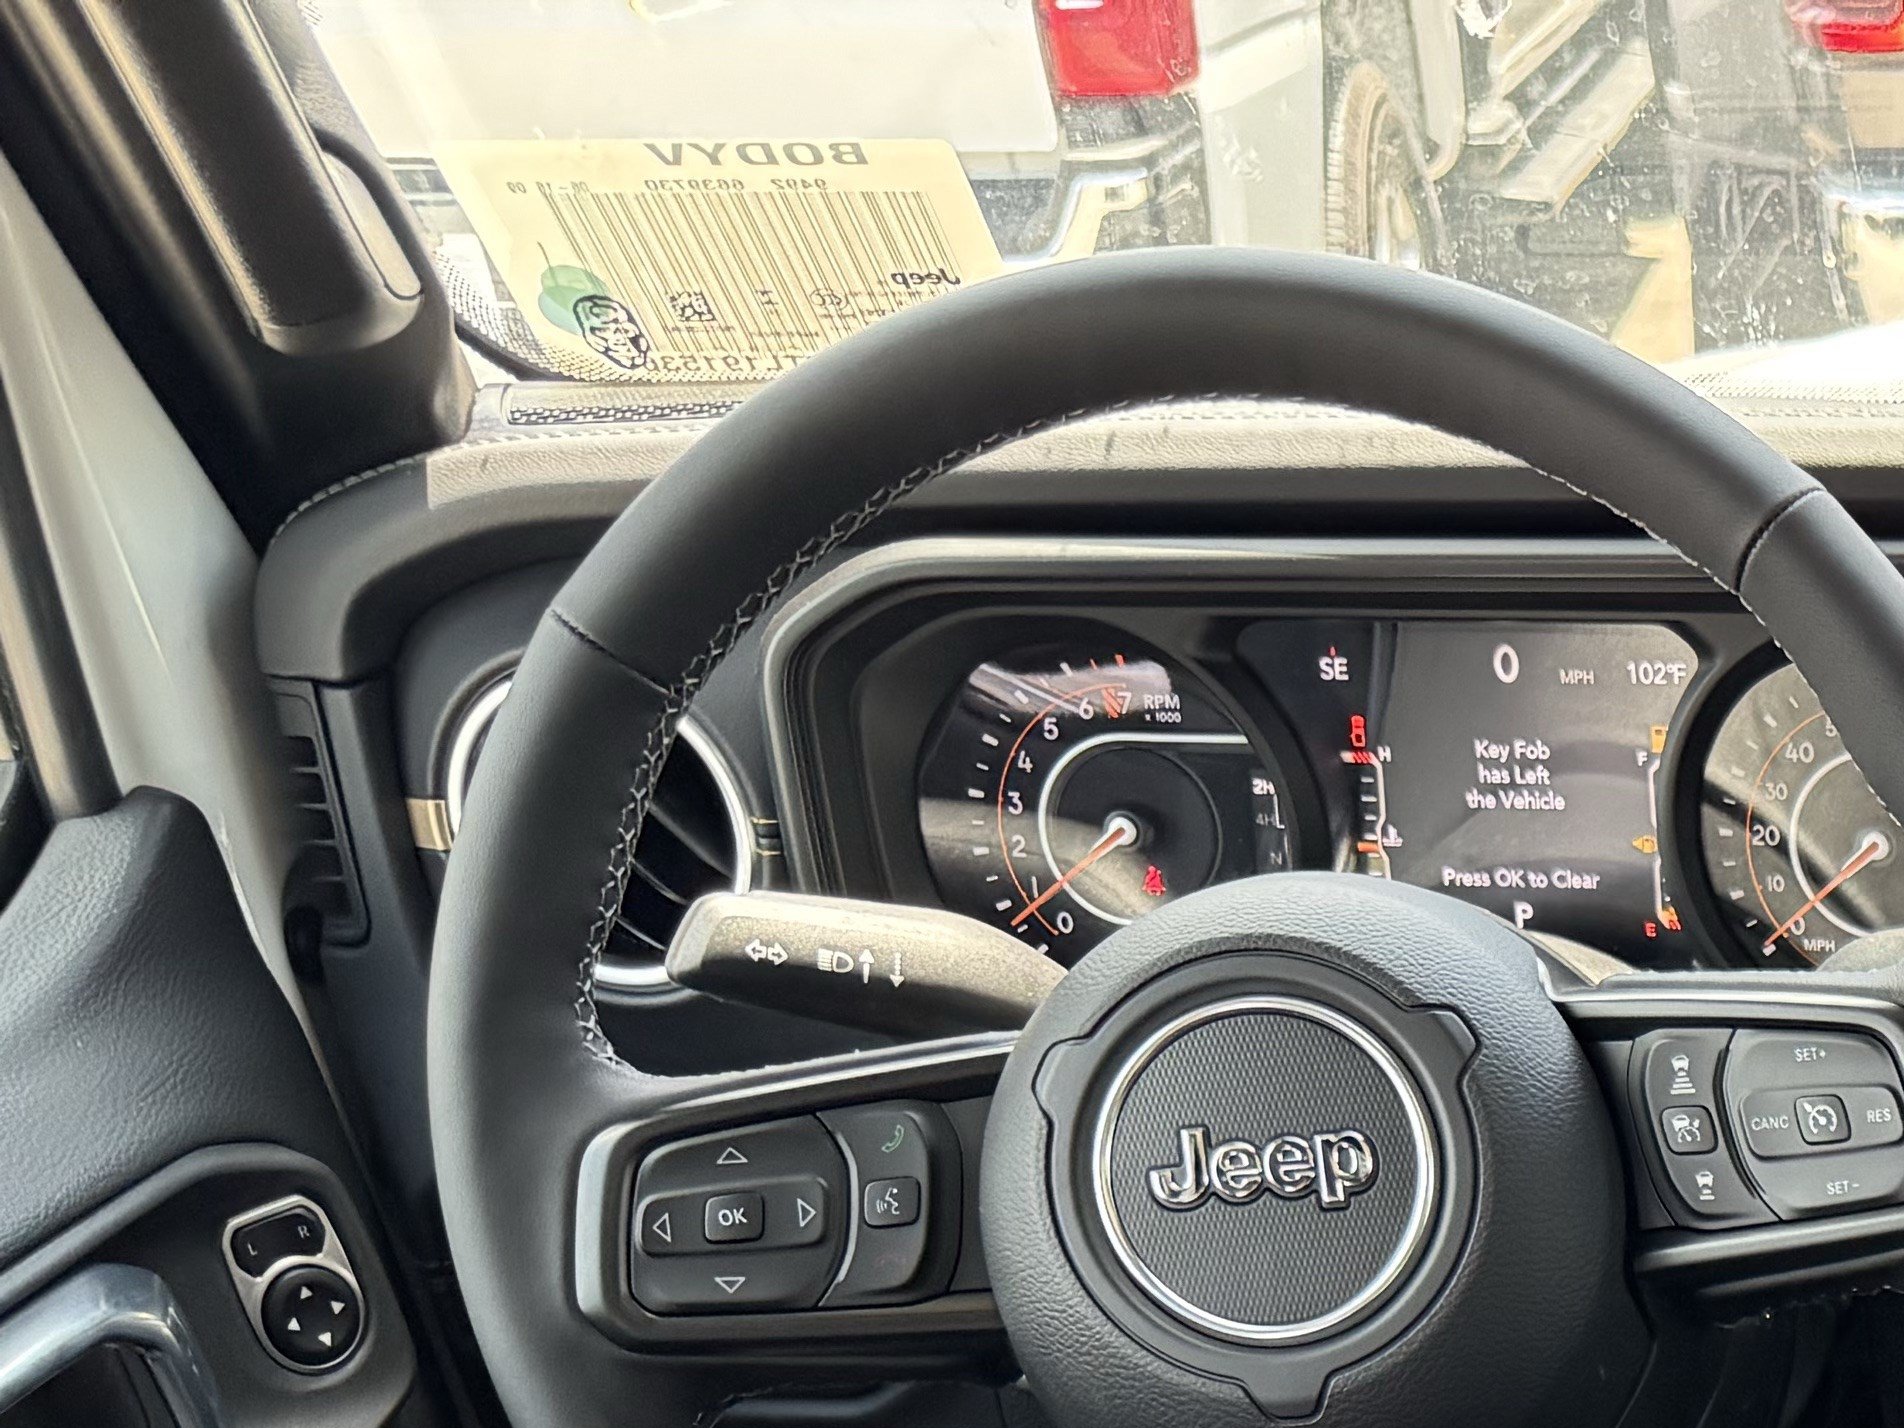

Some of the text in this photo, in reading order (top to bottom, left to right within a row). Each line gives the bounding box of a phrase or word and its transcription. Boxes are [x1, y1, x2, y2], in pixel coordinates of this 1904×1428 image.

[1319, 656, 1348, 681] SE
[1493, 644, 1594, 685] 0 MPH
[1079, 699, 1094, 720] 6
[1116, 692, 1130, 713] 7
[1144, 694, 1180, 710] RPM
[1155, 712, 1181, 723] 1000
[1044, 718, 1058, 740] 5
[1825, 721, 1838, 738] 5
[1378, 746, 1392, 763] H
[1474, 740, 1550, 763] Key Fob
[1636, 751, 1647, 767] F
[1785, 741, 1814, 763] 40
[1018, 752, 1033, 772] 4
[1478, 765, 1550, 786] has Left
[1252, 778, 1275, 794] 2H
[1765, 783, 1788, 800] 30
[1008, 793, 1022, 815] 3
[1466, 790, 1565, 810] the Vehicle
[1752, 825, 1780, 846] 20
[1012, 837, 1026, 858] 2
[1442, 867, 1599, 890] Press OK to Clear
[1768, 875, 1785, 892] 10
[1057, 913, 1074, 934] 0
[1514, 901, 1533, 928] P
[1645, 923, 1657, 937] E
[1804, 939, 1835, 953] MPH
[1751, 1116, 1789, 1130] CANC
[1866, 1109, 1891, 1123] RES
[1150, 1127, 1374, 1208] Jeep
[718, 1208, 747, 1227] OK
[298, 1225, 309, 1238] R
[247, 1242, 258, 1256] L
